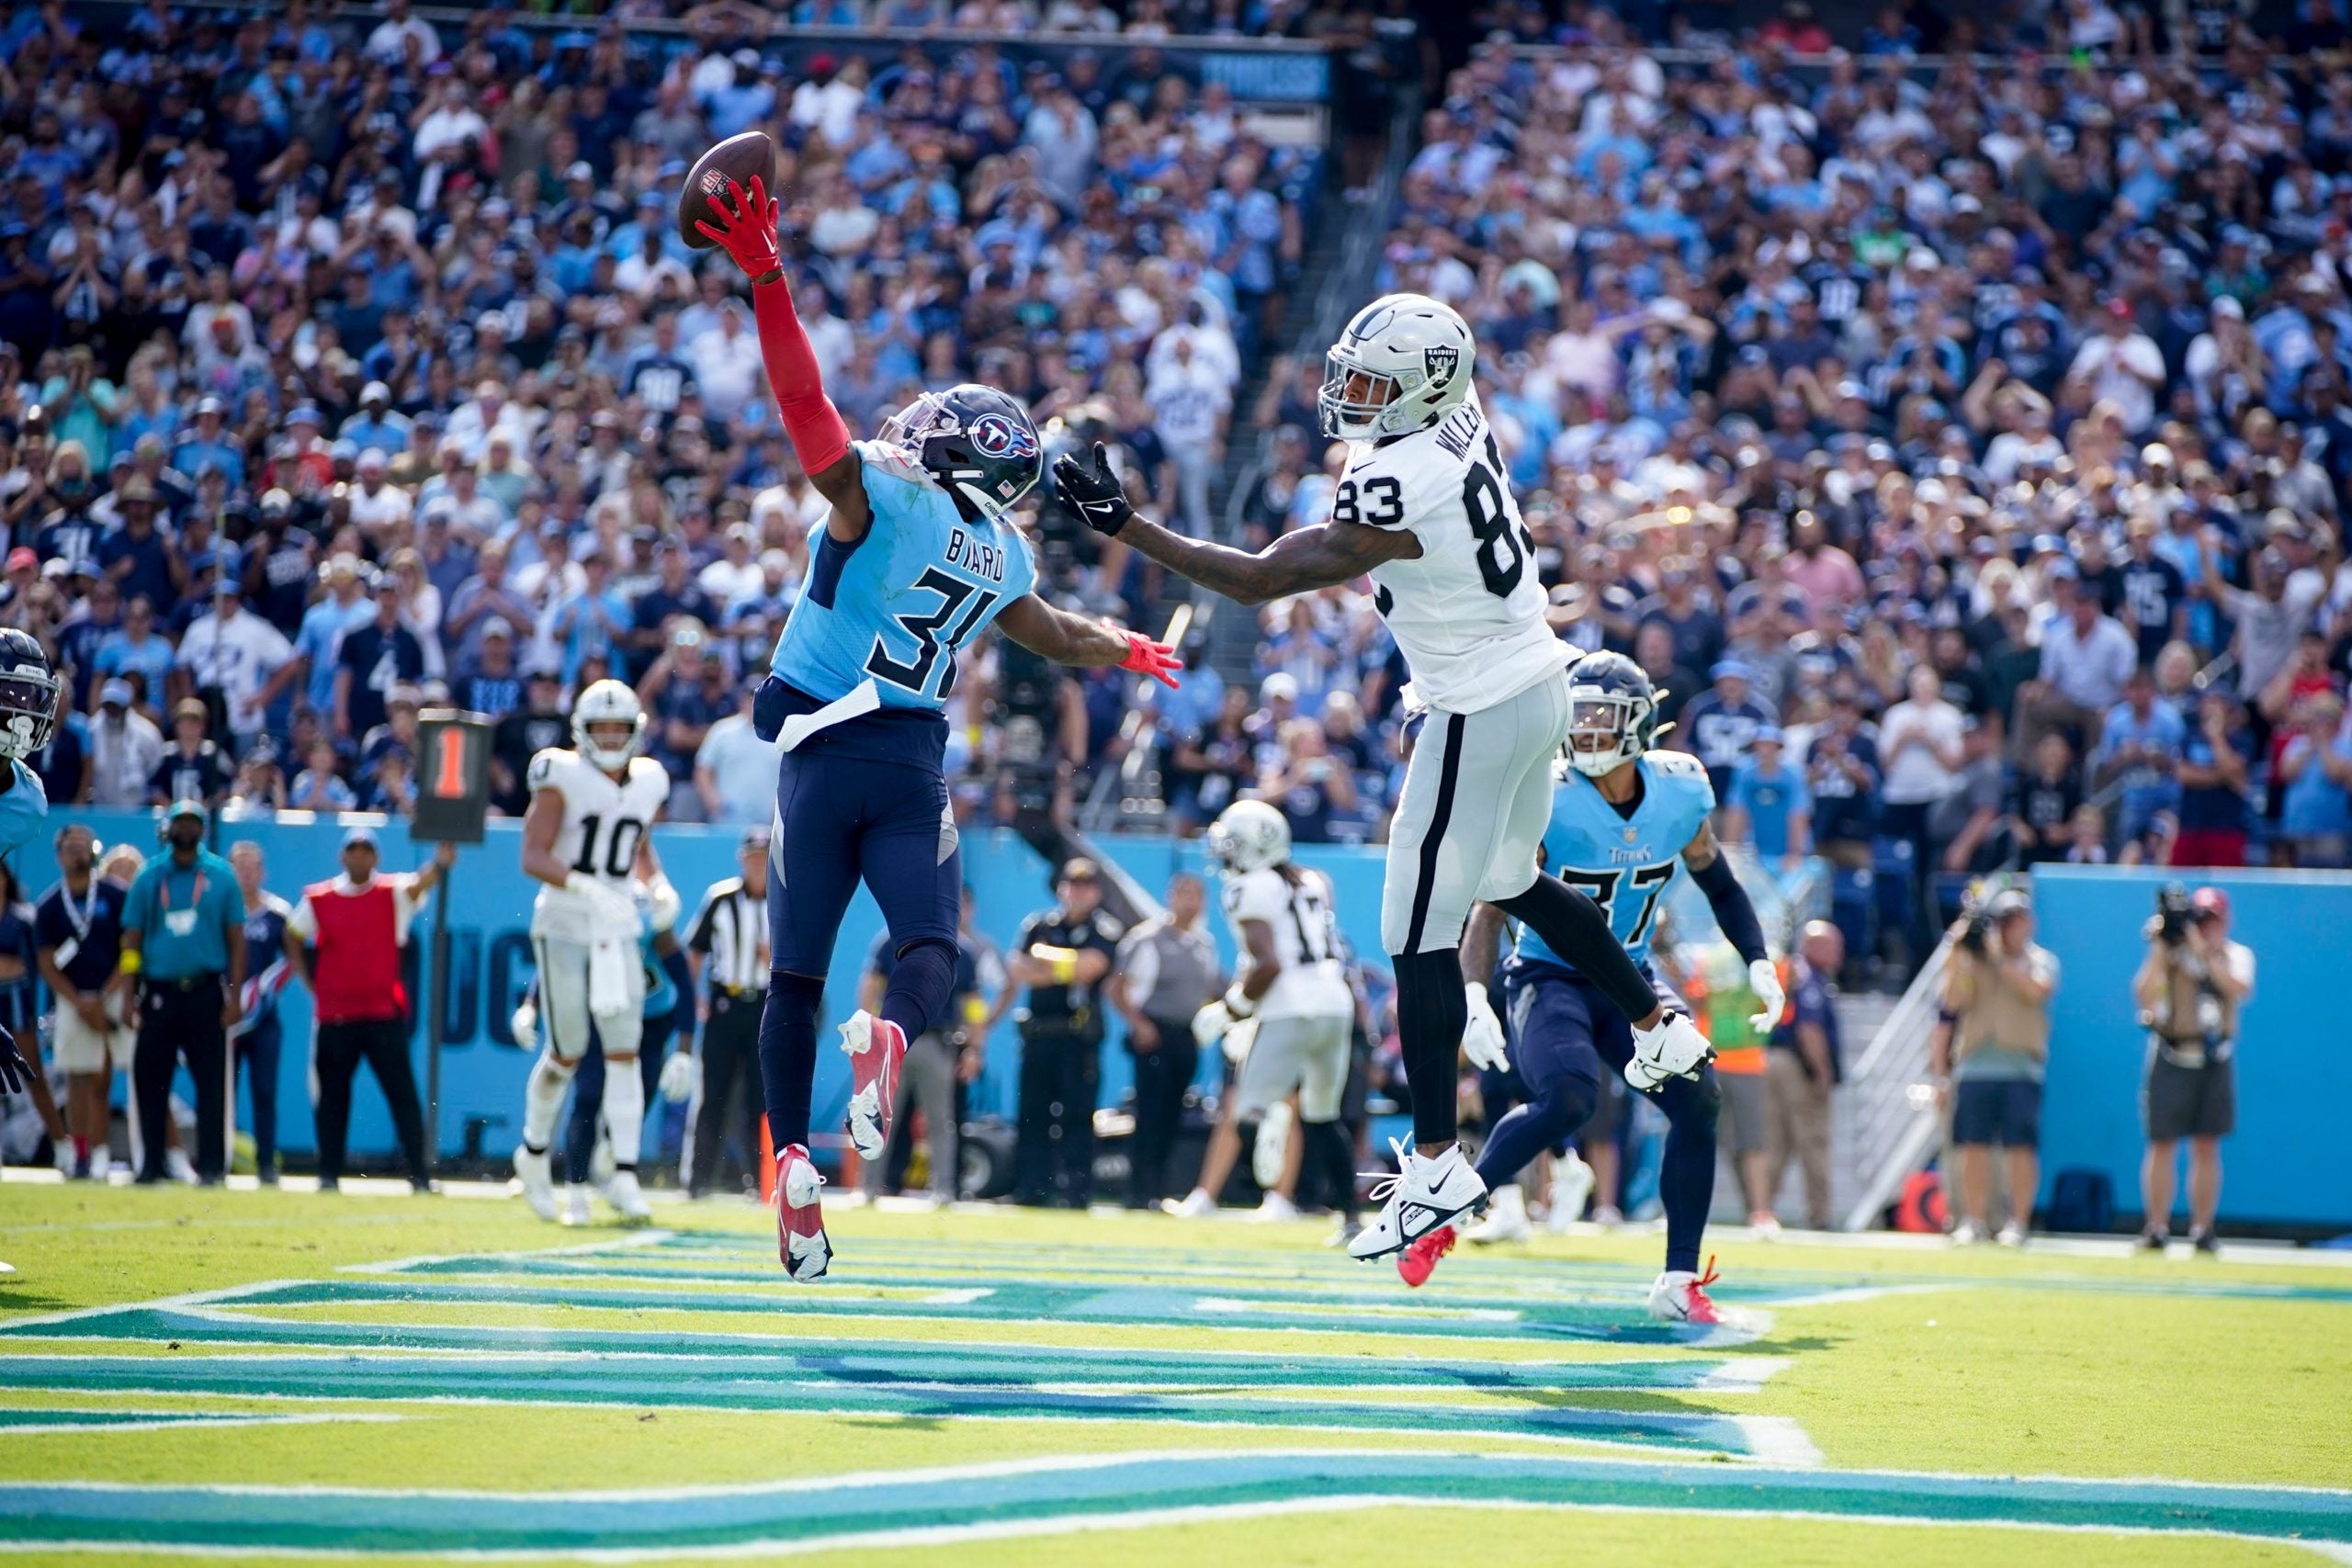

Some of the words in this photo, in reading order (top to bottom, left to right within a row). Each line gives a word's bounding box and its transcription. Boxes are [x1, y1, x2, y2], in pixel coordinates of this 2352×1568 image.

[701, 170, 722, 190] NFL
[1333, 476, 1404, 525] 83
[862, 564, 1002, 702] 31
[435, 726, 466, 799] 1
[571, 815, 643, 877] 10
[1561, 855, 1677, 950] 37
